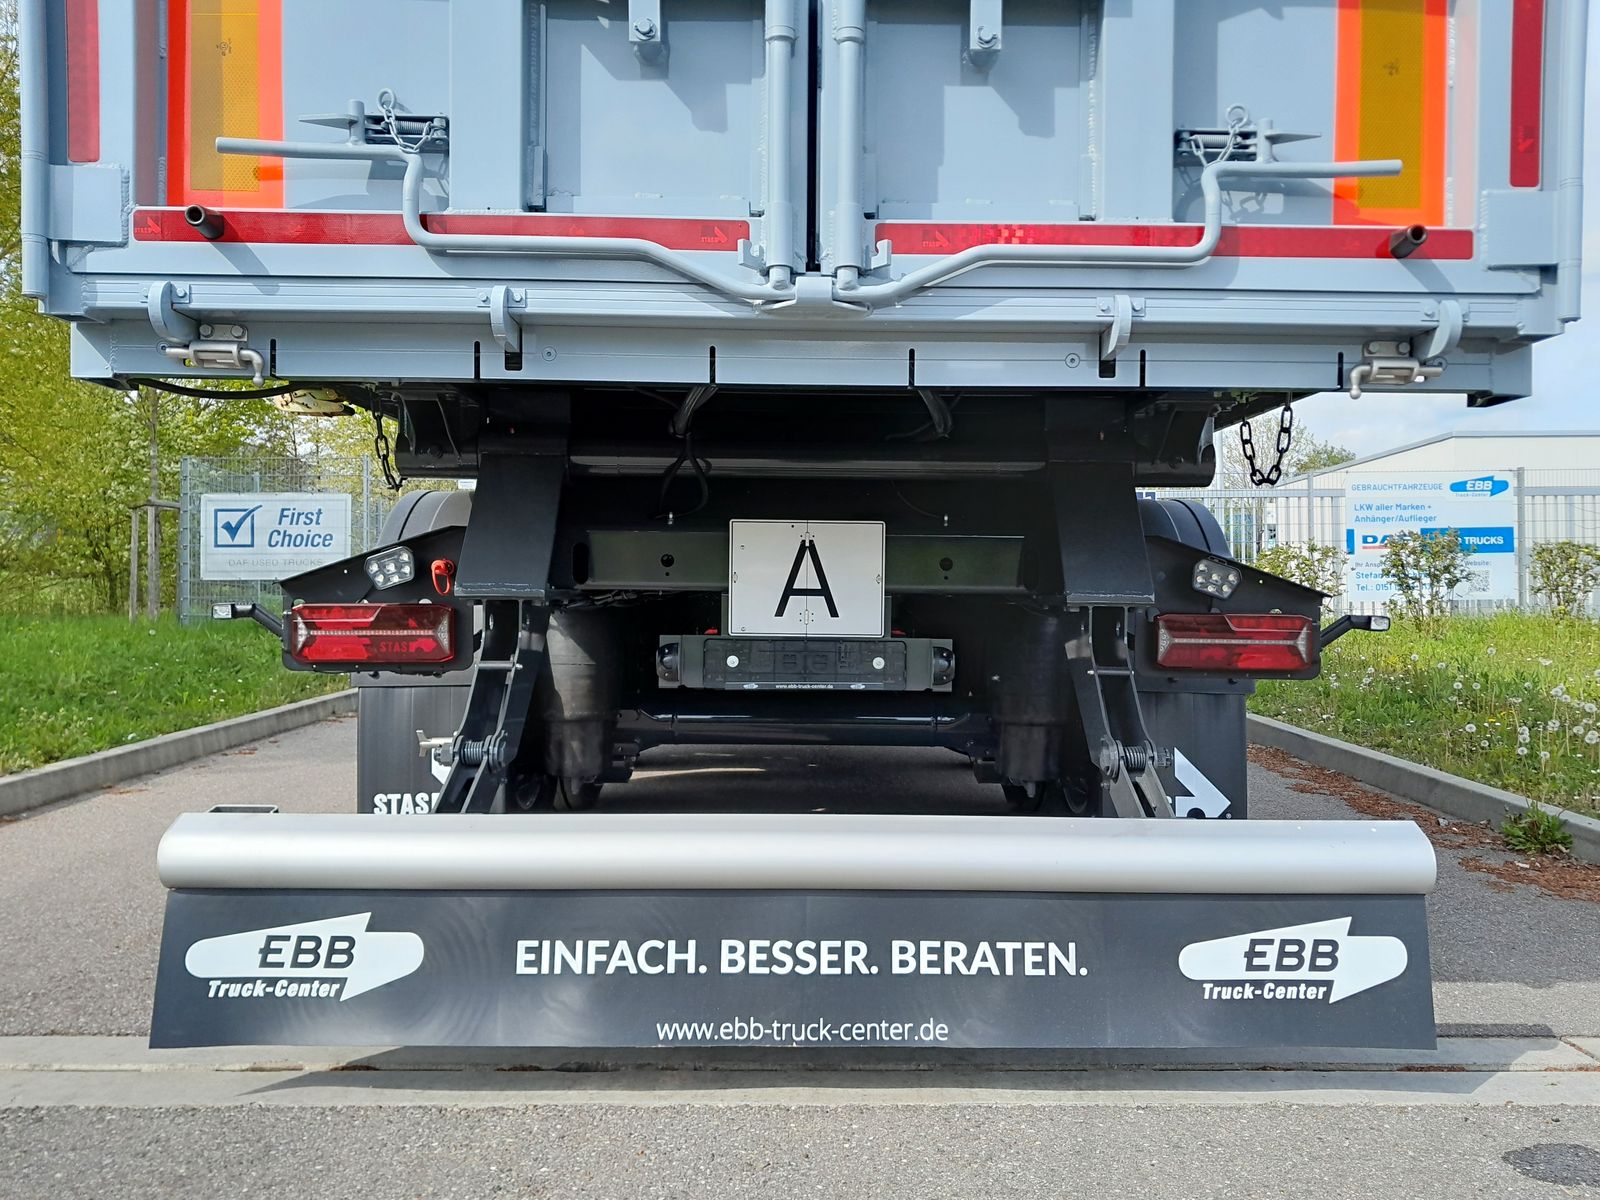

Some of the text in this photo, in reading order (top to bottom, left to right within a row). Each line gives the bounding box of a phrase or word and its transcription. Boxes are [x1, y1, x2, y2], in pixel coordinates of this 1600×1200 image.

[1351, 482, 1444, 492] GEBRAUCHTFAHRZEUGE
[1466, 480, 1493, 491] EBB
[277, 507, 323, 526] First
[1354, 503, 1374, 512] LKW
[1375, 503, 1393, 512] aller
[1395, 503, 1426, 511] Marken
[1354, 514, 1438, 524] Anhänger/Auflieger
[267, 529, 334, 548] Choice
[1463, 536, 1505, 545] TRUCKS
[228, 558, 323, 568] DAF USED TRUCKS
[774, 539, 840, 618] A
[379, 641, 408, 653] STAS
[373, 792, 430, 814] STAS
[258, 934, 356, 969] EBB
[515, 939, 1088, 977] EINFACH. BESSER. BERATEN.
[1243, 938, 1340, 972] EBB
[207, 979, 341, 999] Truck-Center
[1202, 982, 1327, 1000] Truck-Center
[656, 1016, 949, 1042] www.ebb-truck-center.de
